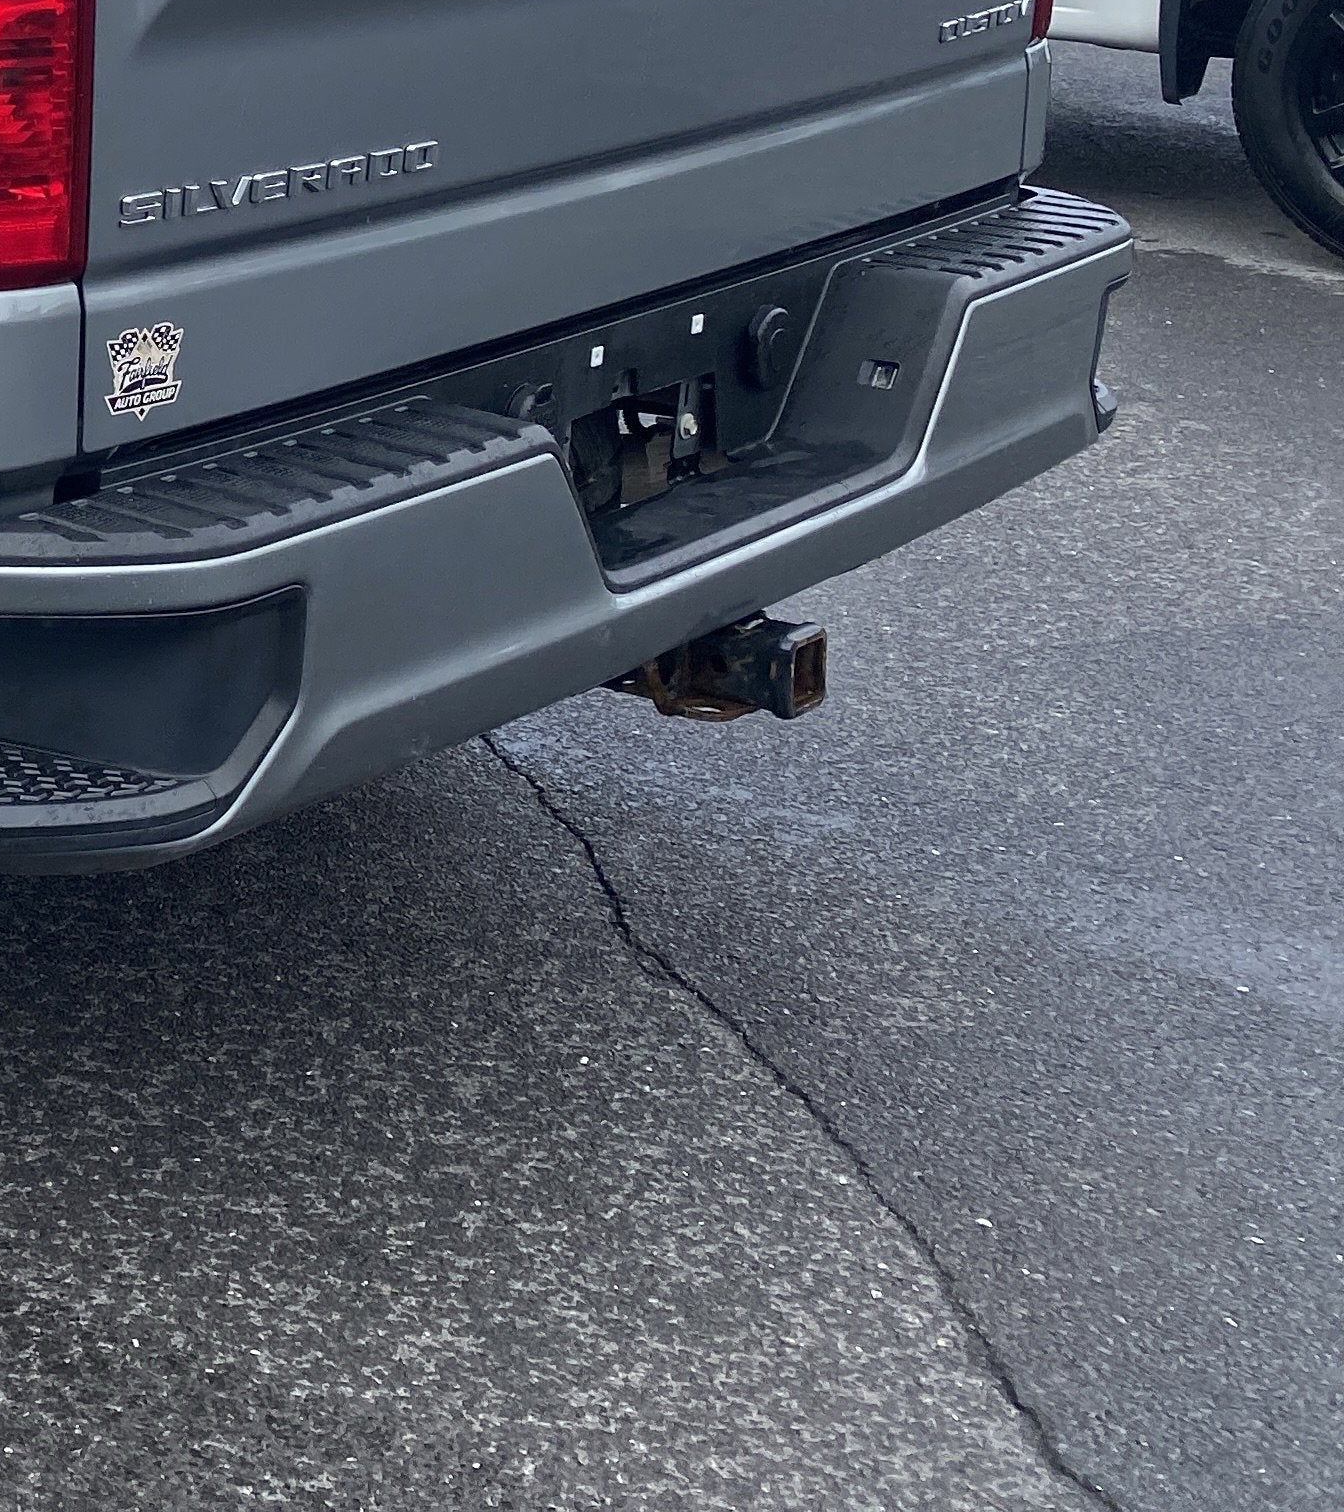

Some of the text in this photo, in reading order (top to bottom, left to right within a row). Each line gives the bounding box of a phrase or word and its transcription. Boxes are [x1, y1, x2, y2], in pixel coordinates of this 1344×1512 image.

[118, 140, 440, 228] SILVERADO
[114, 387, 175, 409] AUTO GROUP
